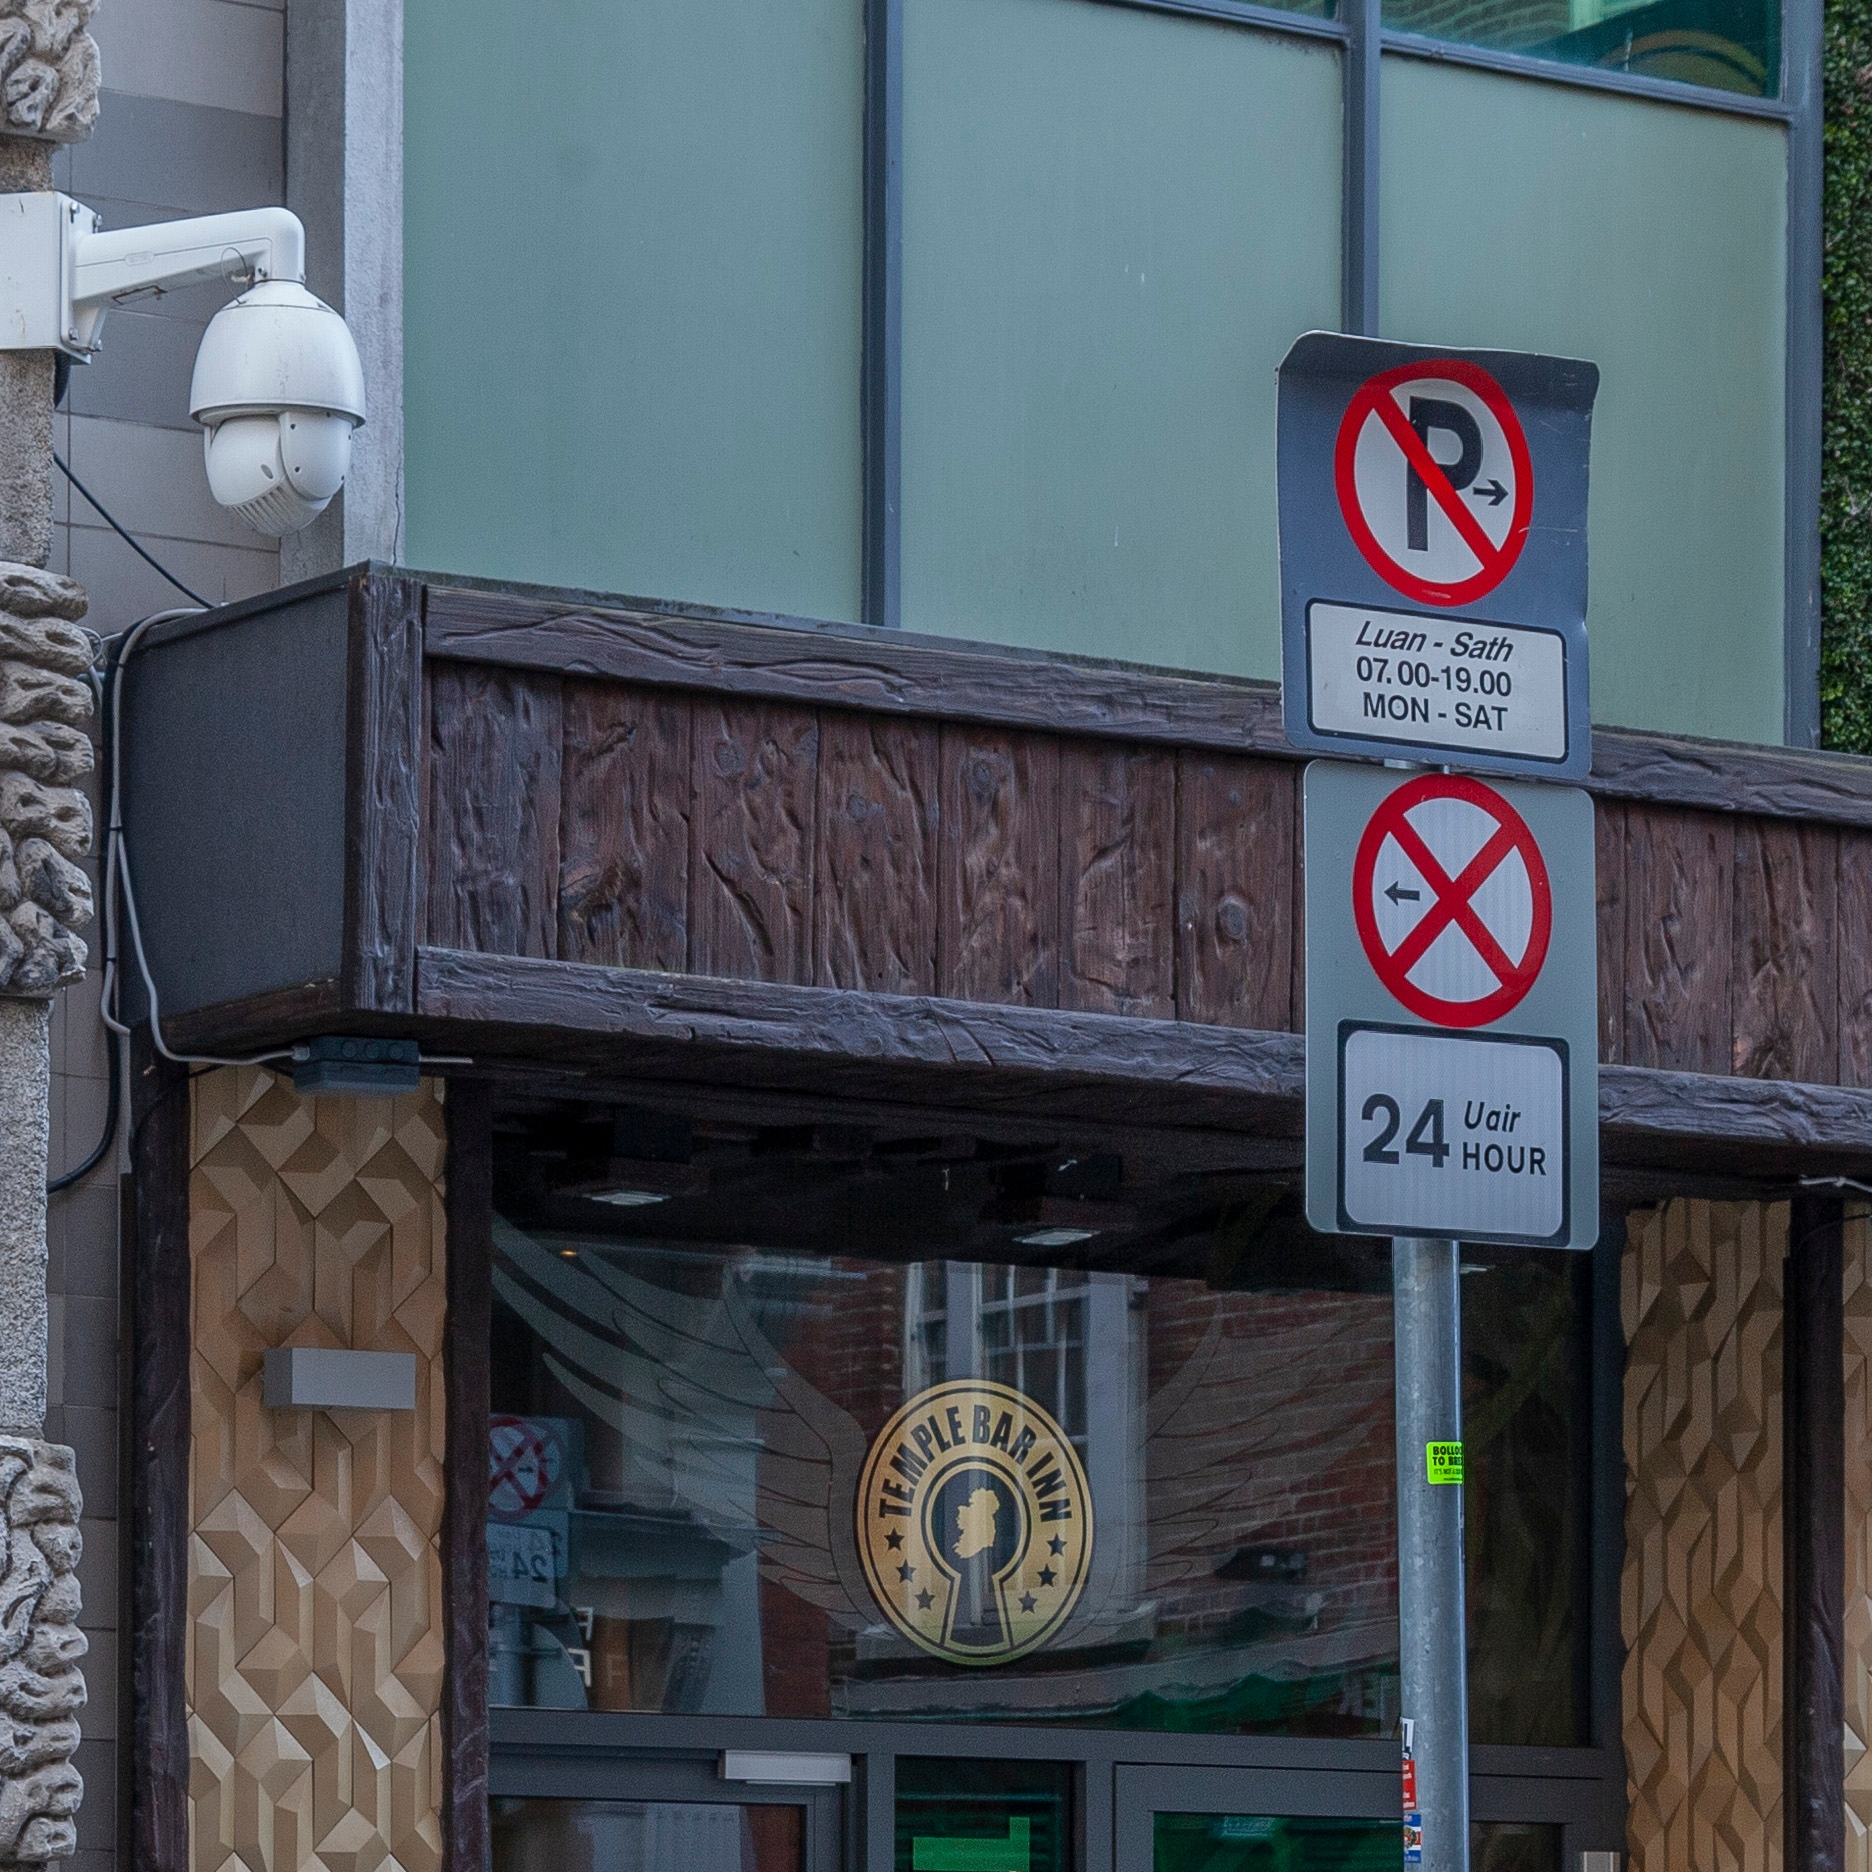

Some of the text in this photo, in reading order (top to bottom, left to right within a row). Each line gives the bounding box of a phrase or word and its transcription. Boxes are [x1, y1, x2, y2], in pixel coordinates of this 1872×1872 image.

[1355, 620, 1427, 652] Luan
[1450, 631, 1515, 663] Sath
[1363, 691, 1429, 723] MON
[1454, 701, 1509, 732] SAT
[1361, 1093, 1450, 1168] 24
[1463, 1100, 1522, 1133] Uair
[1462, 1141, 1547, 1176] HOUR
[879, 1404, 1073, 1523] TEMPLE BAR INN
